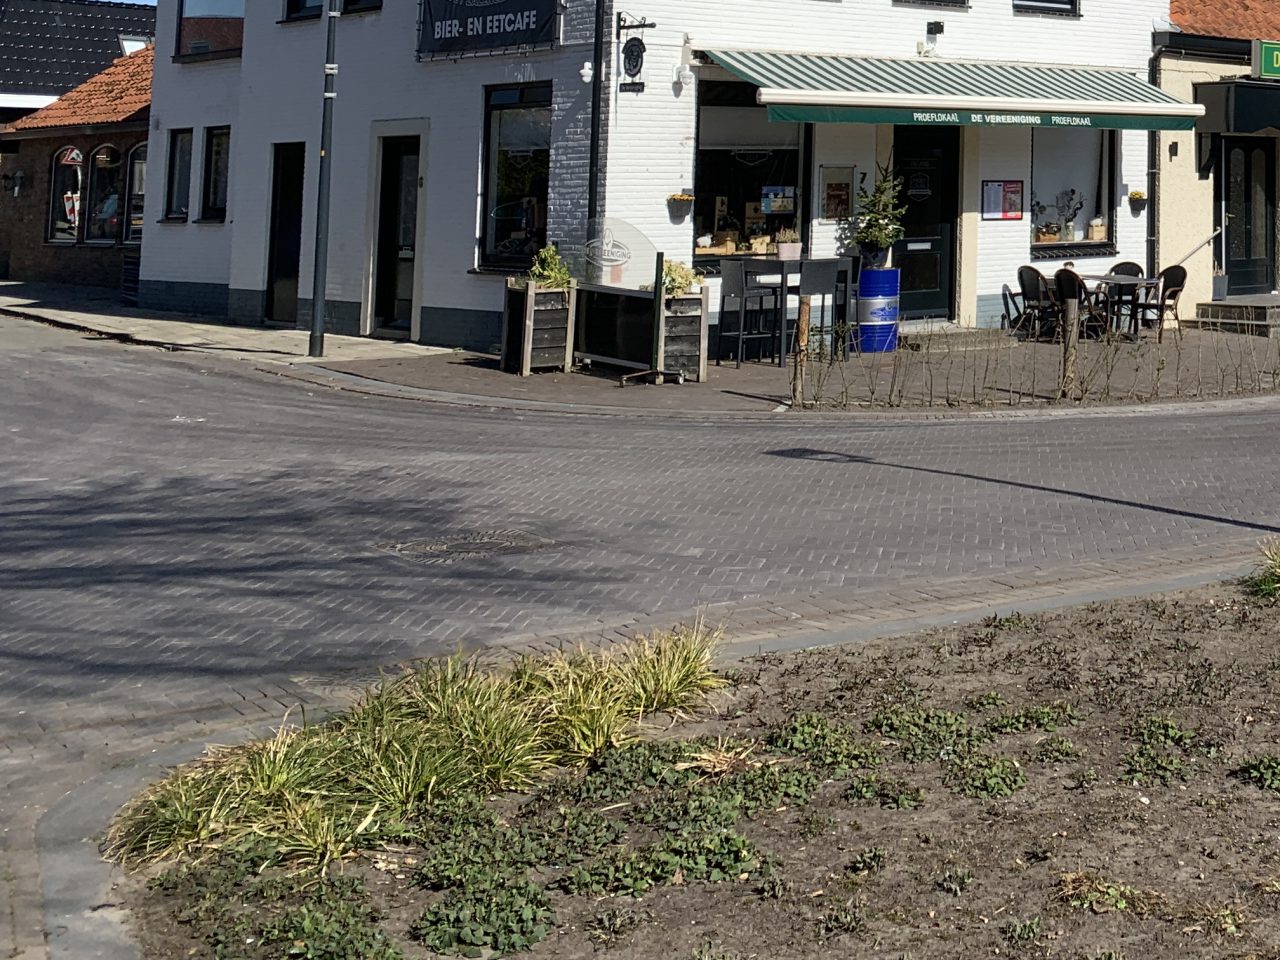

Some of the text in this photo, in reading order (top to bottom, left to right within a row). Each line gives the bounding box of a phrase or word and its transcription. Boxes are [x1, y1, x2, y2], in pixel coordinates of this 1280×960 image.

[434, 10, 537, 39] BIER- EN EETCAFE
[913, 112, 1092, 126] PROEFLOKAAL DE VEREENIGING PROEFLOKAAL
[860, 172, 867, 184] 7
